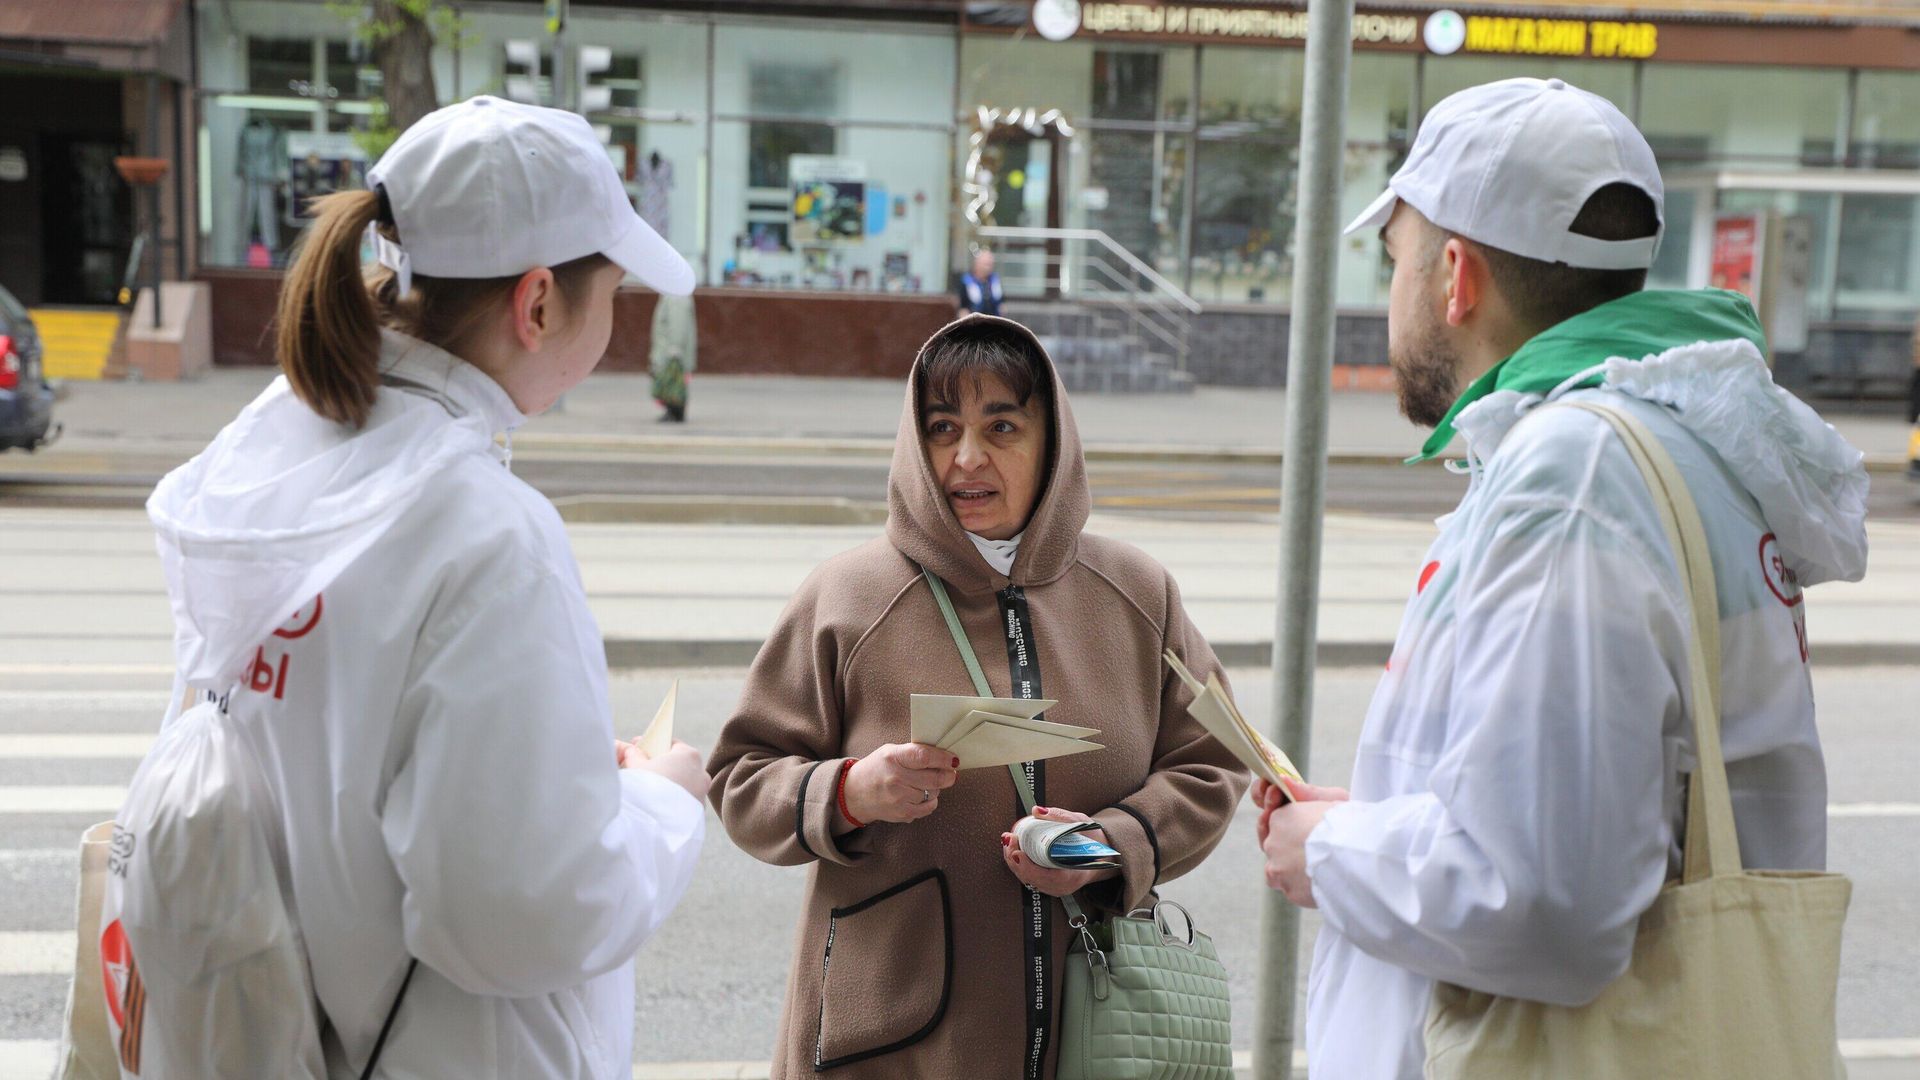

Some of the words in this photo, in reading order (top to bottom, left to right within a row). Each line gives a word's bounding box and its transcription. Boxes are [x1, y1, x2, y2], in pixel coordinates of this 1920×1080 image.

[1083, 3, 1165, 33] ЦВЕТЫ
[1166, 6, 1187, 33] И
[1351, 14, 1417, 43] ЛОЧИ
[1465, 16, 1587, 56] МАГАЗИН
[1589, 21, 1657, 57] ТРАВ
[1007, 609, 1016, 639] MOSCHINO
[1015, 618, 1028, 667] MOSCHINO
[1025, 760, 1035, 795] SCHIN
[1033, 956, 1043, 1010] MOSCHINO
